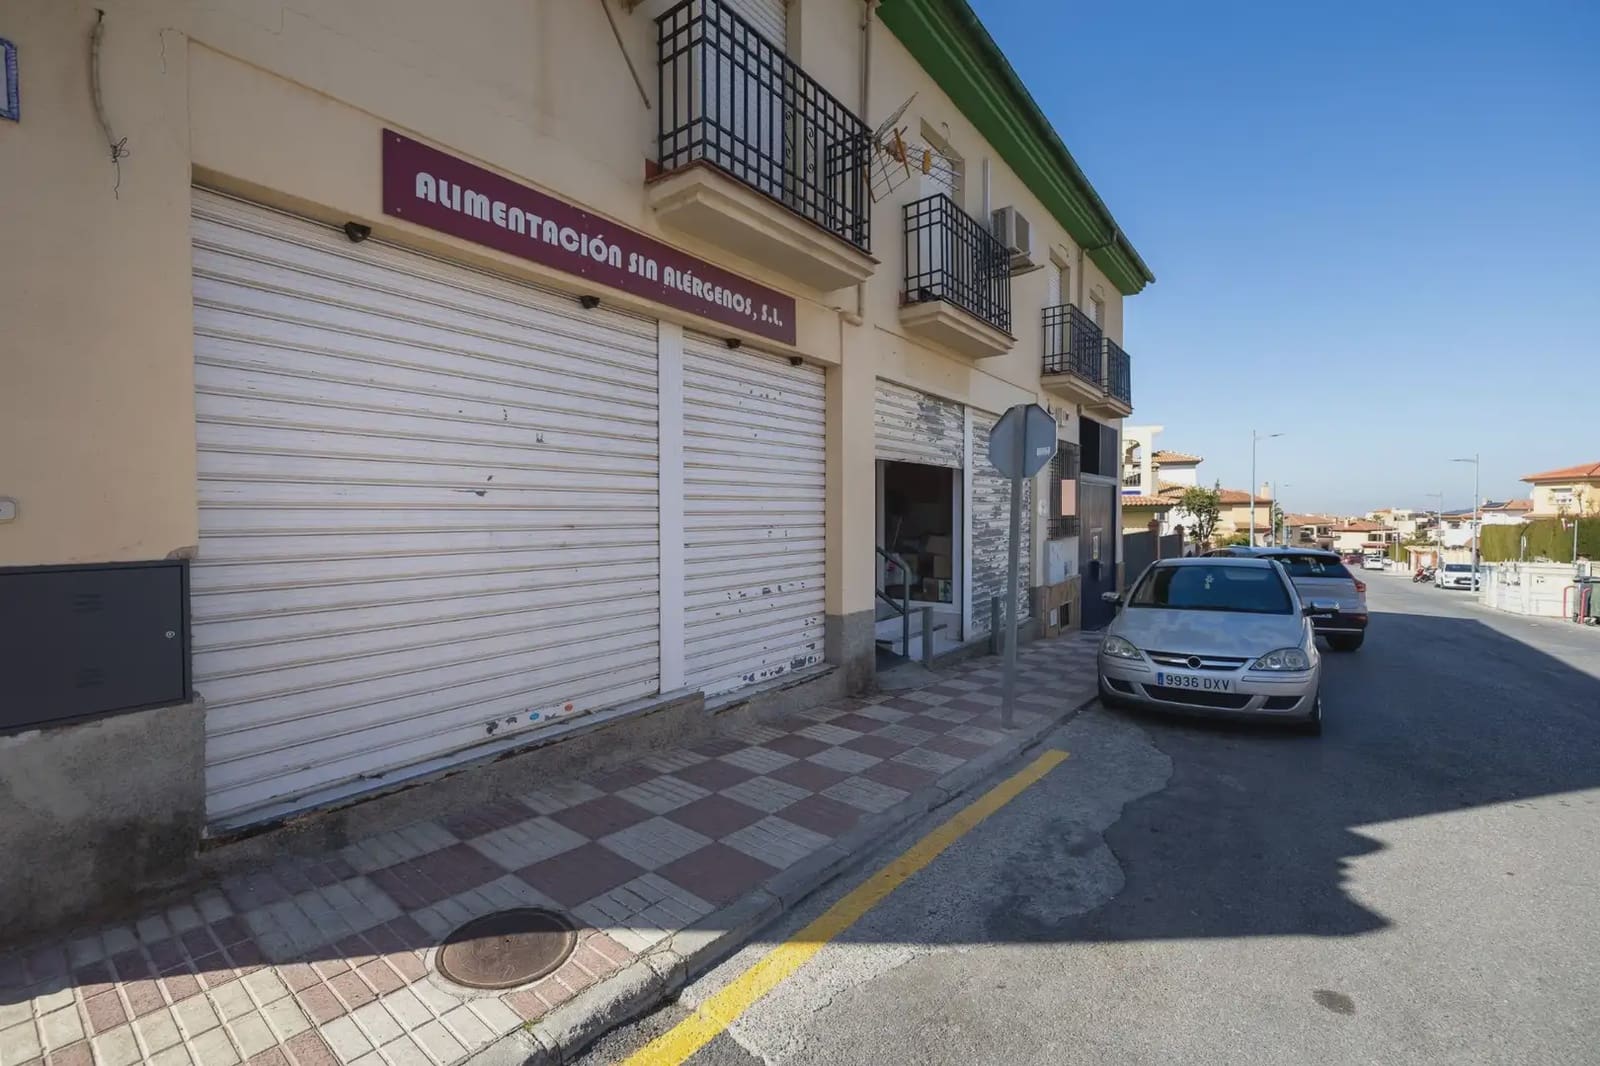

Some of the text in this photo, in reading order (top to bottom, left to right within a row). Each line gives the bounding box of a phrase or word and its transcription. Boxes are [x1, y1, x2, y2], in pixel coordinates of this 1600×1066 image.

[415, 172, 783, 327] ALIMENTACIÓN SIN ALÉRGENOS, S.L.
[1166, 674, 1230, 691] 9936 DXV
